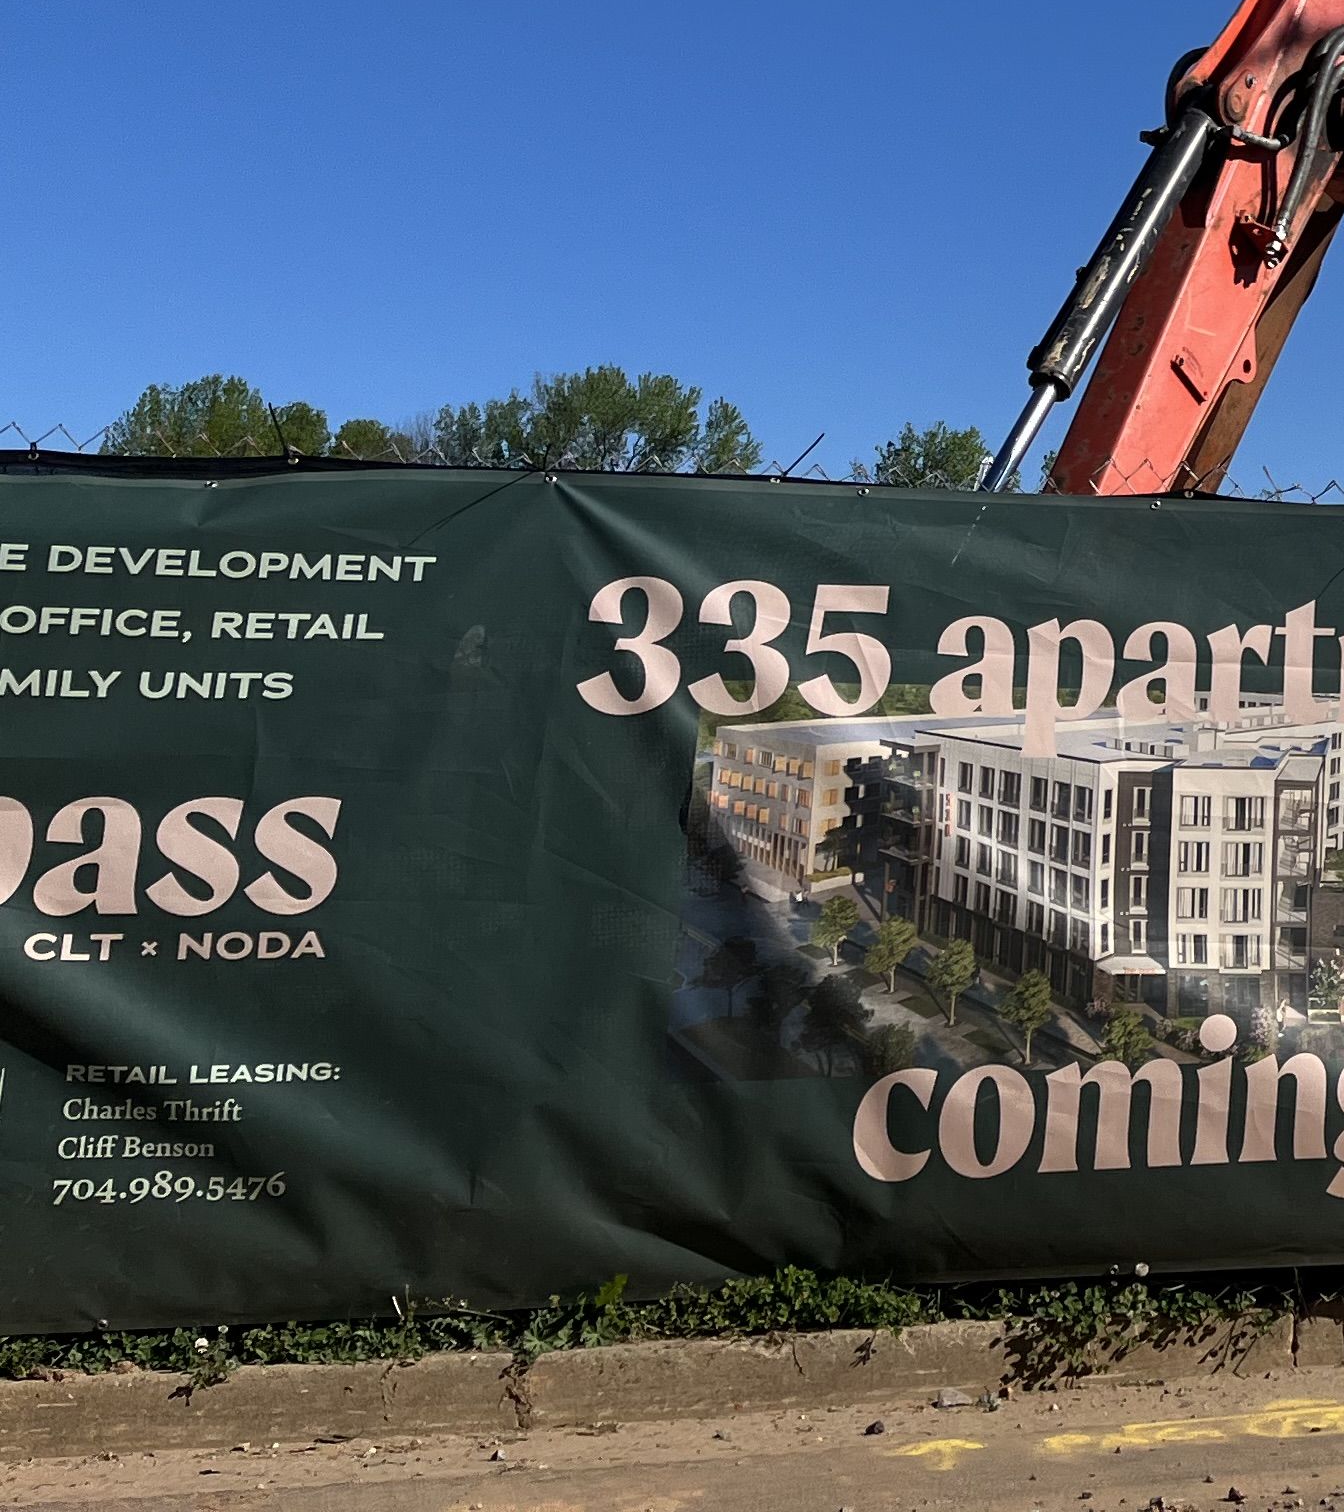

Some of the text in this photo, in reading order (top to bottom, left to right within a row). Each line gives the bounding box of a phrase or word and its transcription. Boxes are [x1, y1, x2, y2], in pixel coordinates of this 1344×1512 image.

[47, 545, 438, 582] DEVELOPMENT
[0, 605, 385, 644] OFFICE, RETAIL
[576, 576, 892, 717] 335
[139, 672, 295, 700] UNITS
[24, 933, 124, 961] CLT
[177, 931, 326, 960] NODA
[66, 1062, 341, 1085] RETAIL LEASING:
[62, 1097, 243, 1122] Charles Thrift
[57, 1135, 215, 1160] Cliff Benson
[52, 1170, 286, 1206] 704.989.5476
